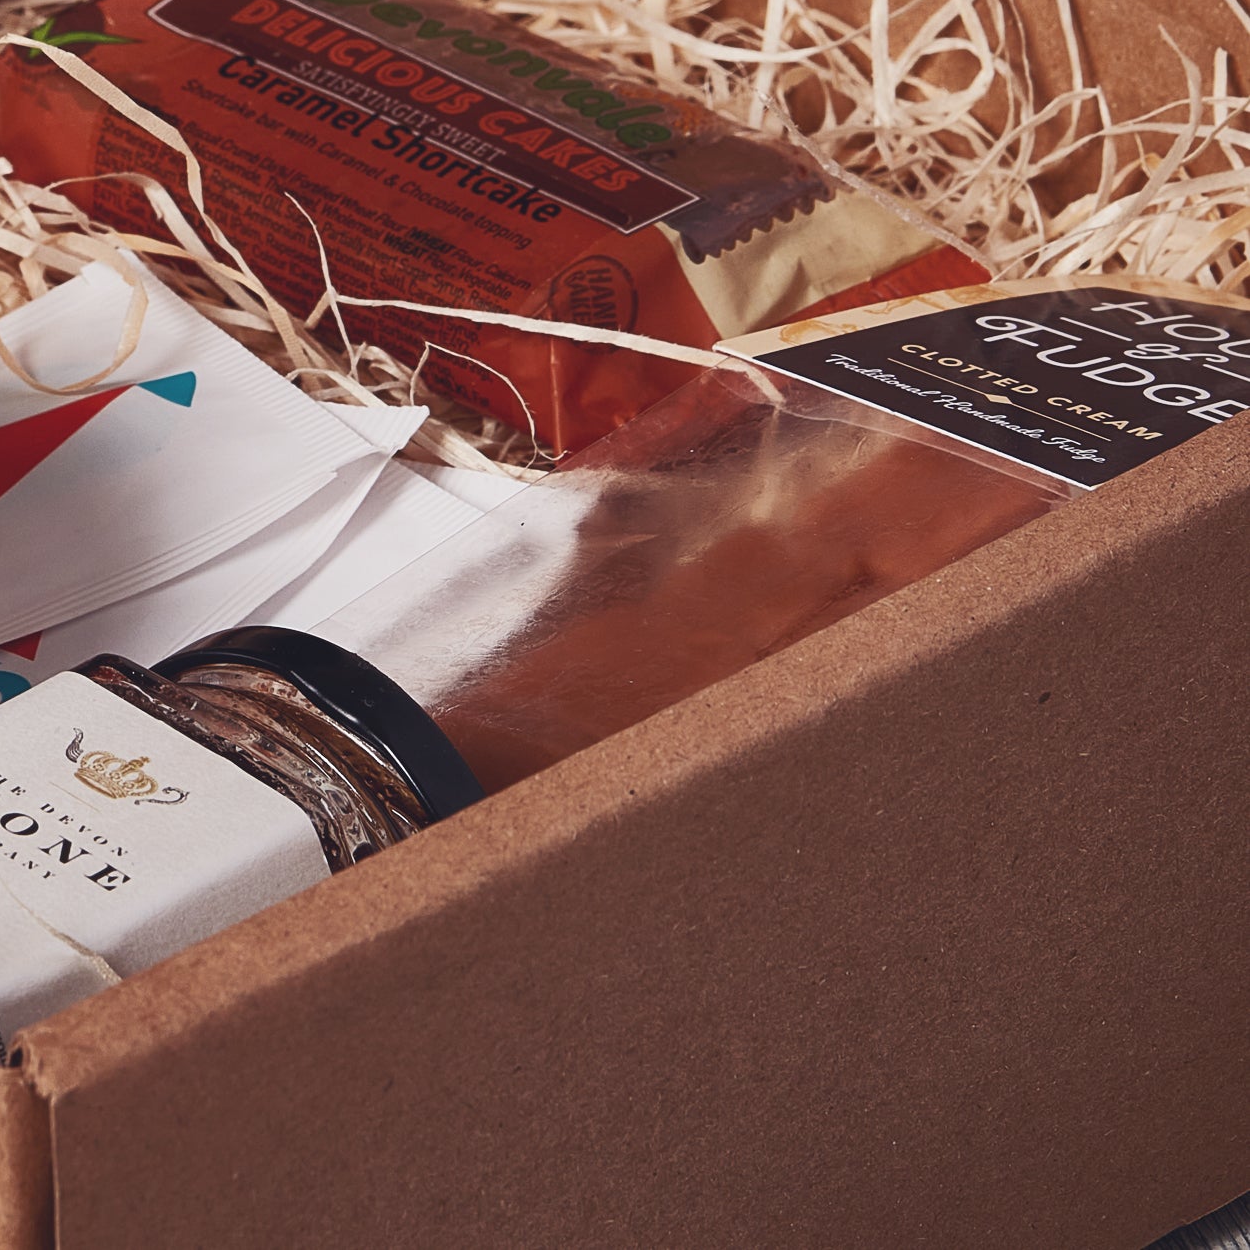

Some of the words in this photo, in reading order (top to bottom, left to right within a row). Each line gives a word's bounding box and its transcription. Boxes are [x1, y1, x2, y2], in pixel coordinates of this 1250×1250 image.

[217, 54, 379, 138] Caramel
[370, 125, 563, 223] Shortcake
[293, 59, 436, 131] SATISFYINGLY
[431, 122, 507, 163] SWEET
[479, 110, 642, 191] CAKES
[181, 79, 257, 119] Shortcake
[255, 113, 285, 131] bar
[283, 127, 318, 148] with
[317, 142, 387, 180] Caramel
[382, 174, 401, 187] &
[399, 180, 476, 223] Chocolate
[473, 216, 533, 250] topping
[457, 265, 513, 300] Vegetable
[563, 271, 591, 324] BAKE
[900, 343, 1039, 396] CLOTTED
[1046, 396, 1164, 441] CREAM
[975, 315, 1250, 424] FUDGE
[1123, 343, 1230, 363] of
[825, 353, 942, 397] Traditional
[932, 394, 1044, 440] Handmade
[1041, 436, 1107, 464] Fudge
[39, 802, 128, 858] DEVON
